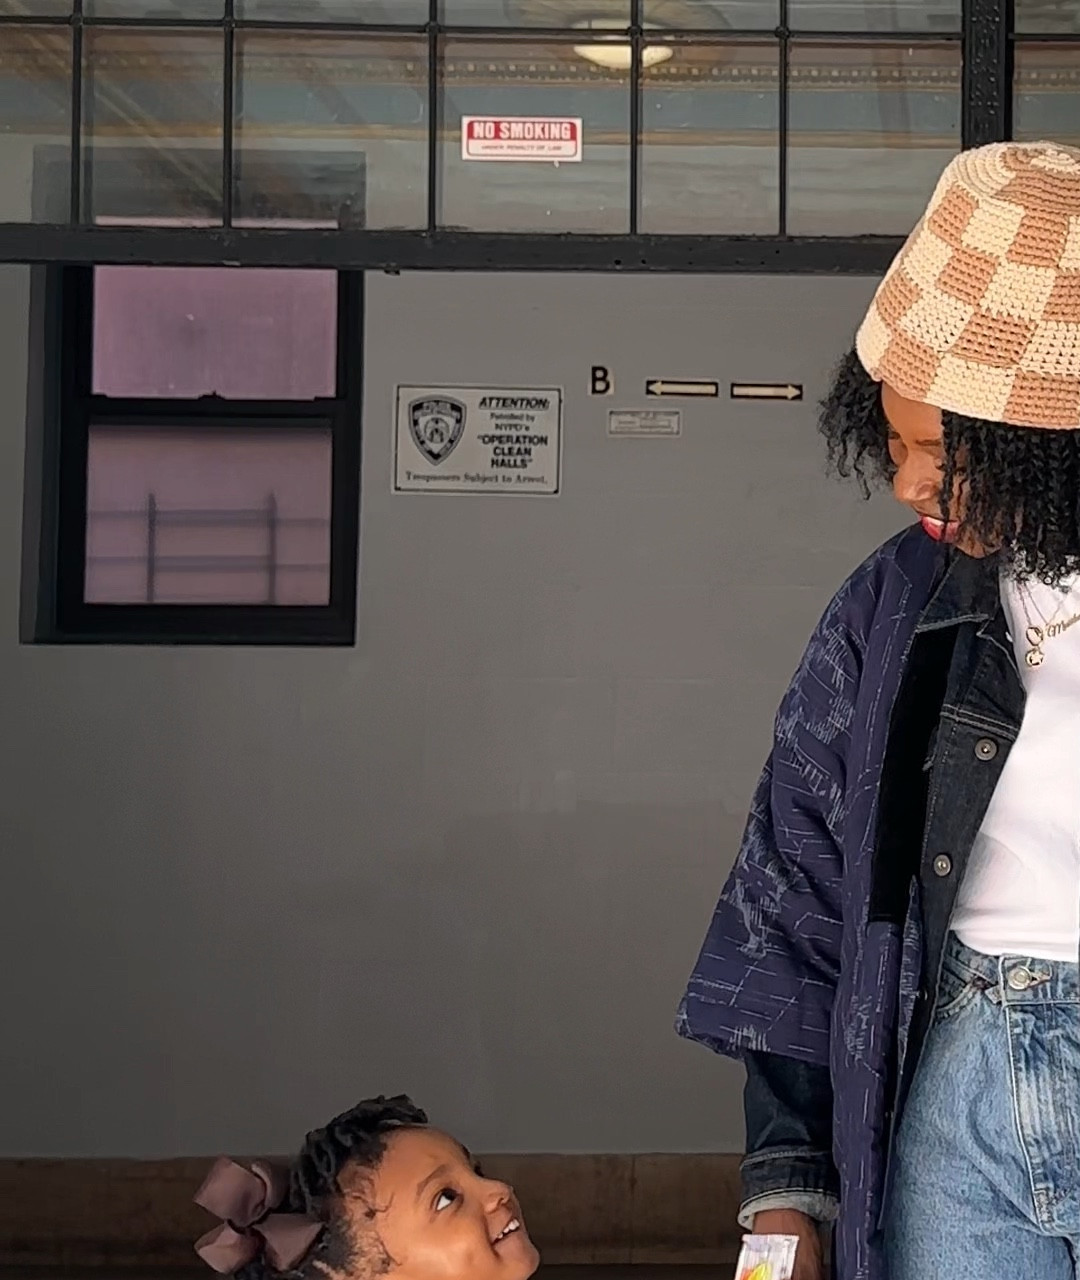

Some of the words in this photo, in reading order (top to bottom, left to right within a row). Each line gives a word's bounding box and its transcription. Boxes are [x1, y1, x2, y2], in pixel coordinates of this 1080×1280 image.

[473, 122, 495, 139] NO
[499, 122, 571, 140] SMOKING
[591, 366, 611, 395] B
[493, 446, 533, 457] CLEAN
